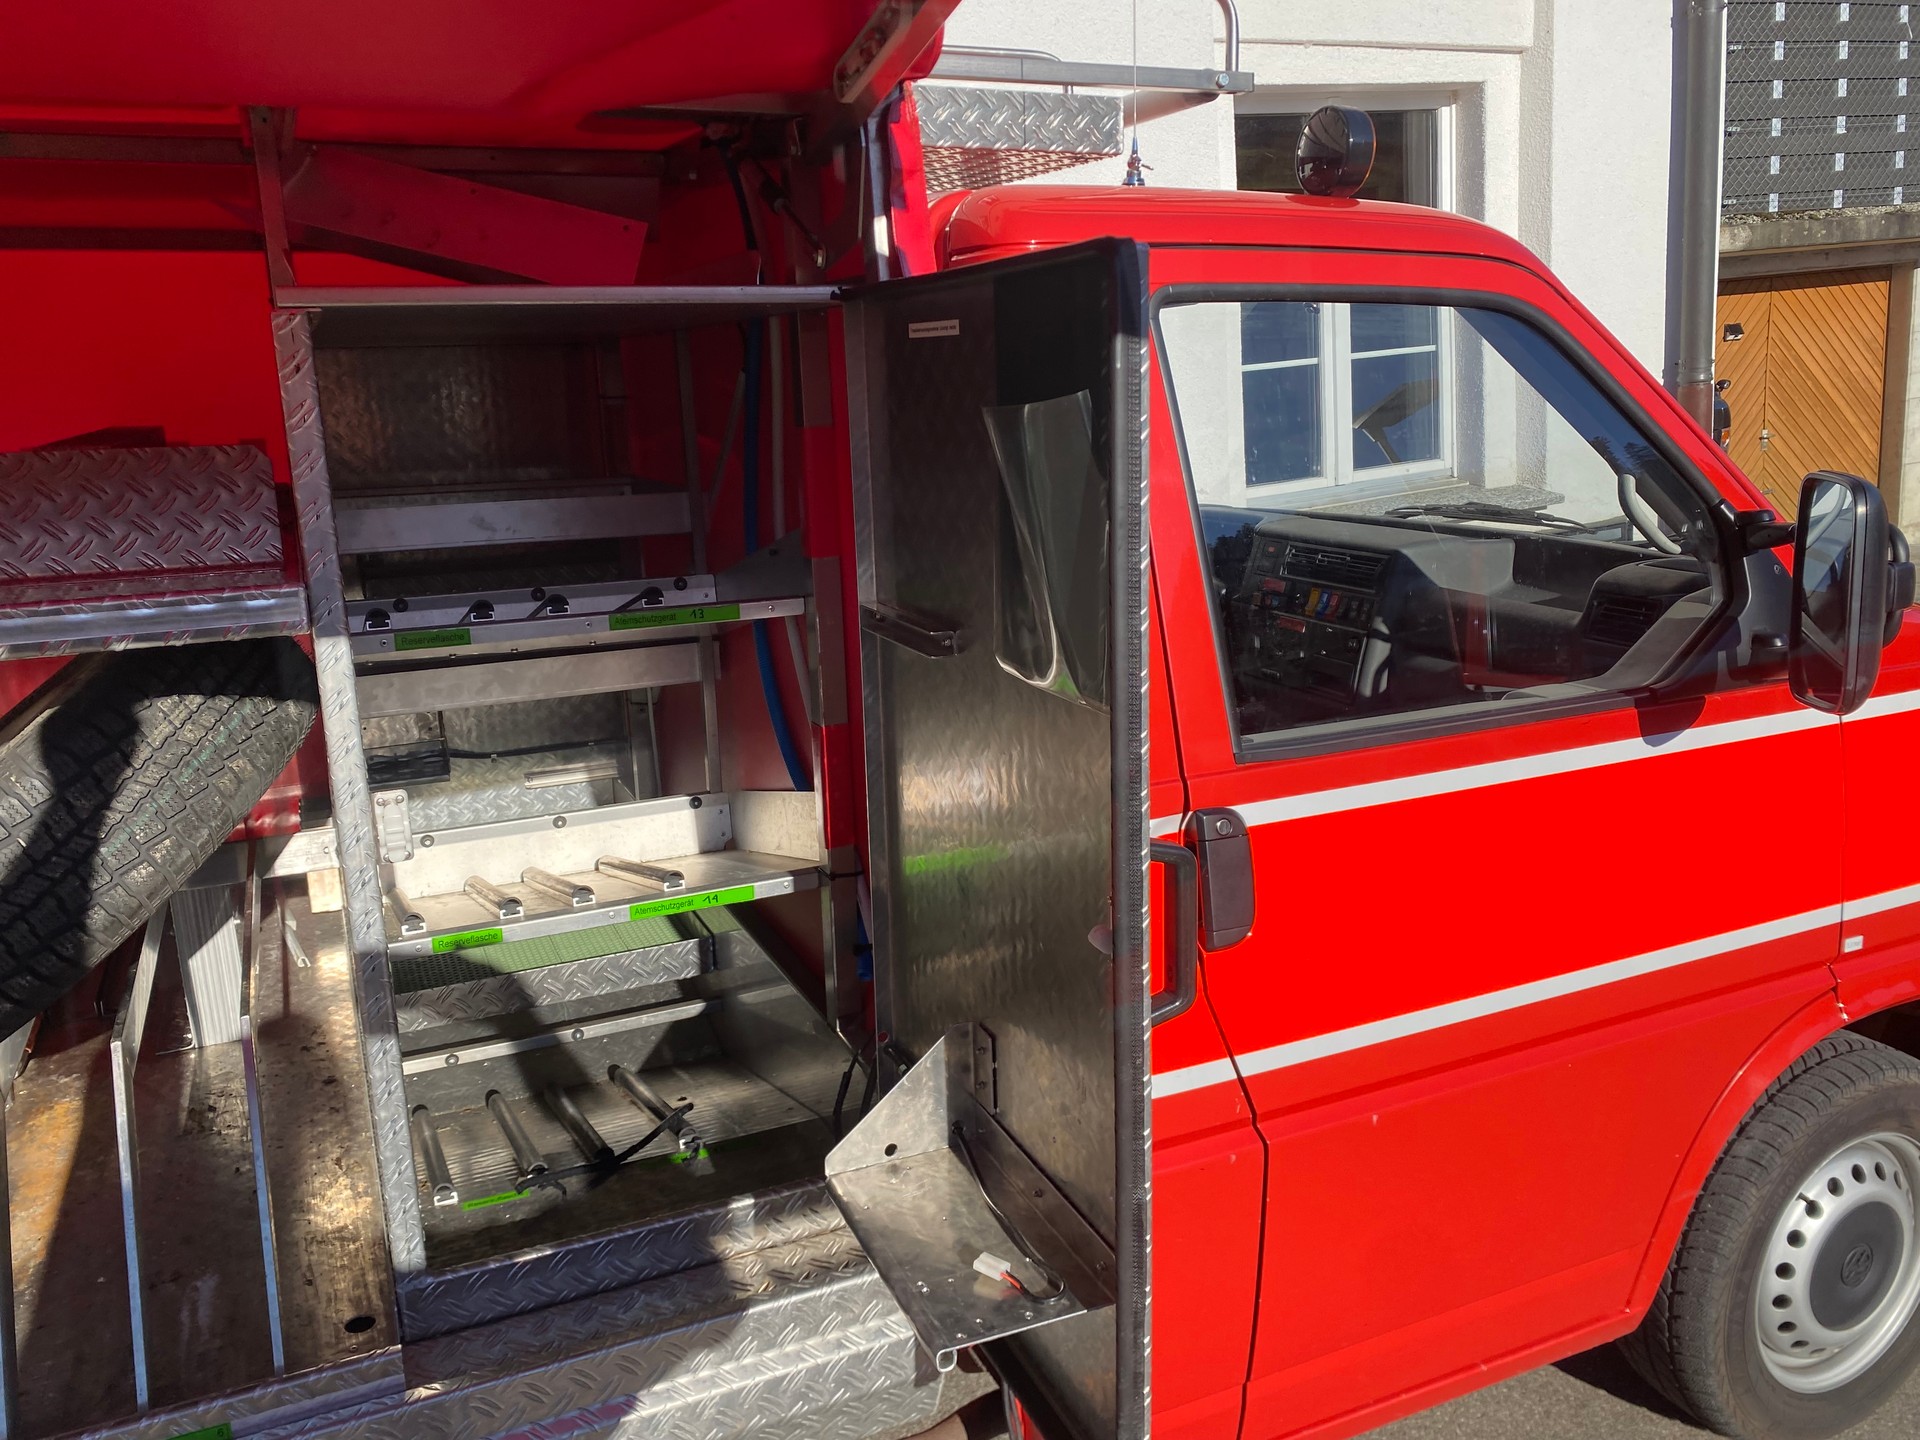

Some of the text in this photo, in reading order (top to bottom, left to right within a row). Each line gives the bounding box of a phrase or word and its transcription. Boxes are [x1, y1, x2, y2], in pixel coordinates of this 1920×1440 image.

[690, 608, 705, 619] 13
[401, 633, 465, 646] Reserveflasche
[634, 899, 694, 916] Atemschutzgerät
[438, 932, 498, 949] Reserveflasche
